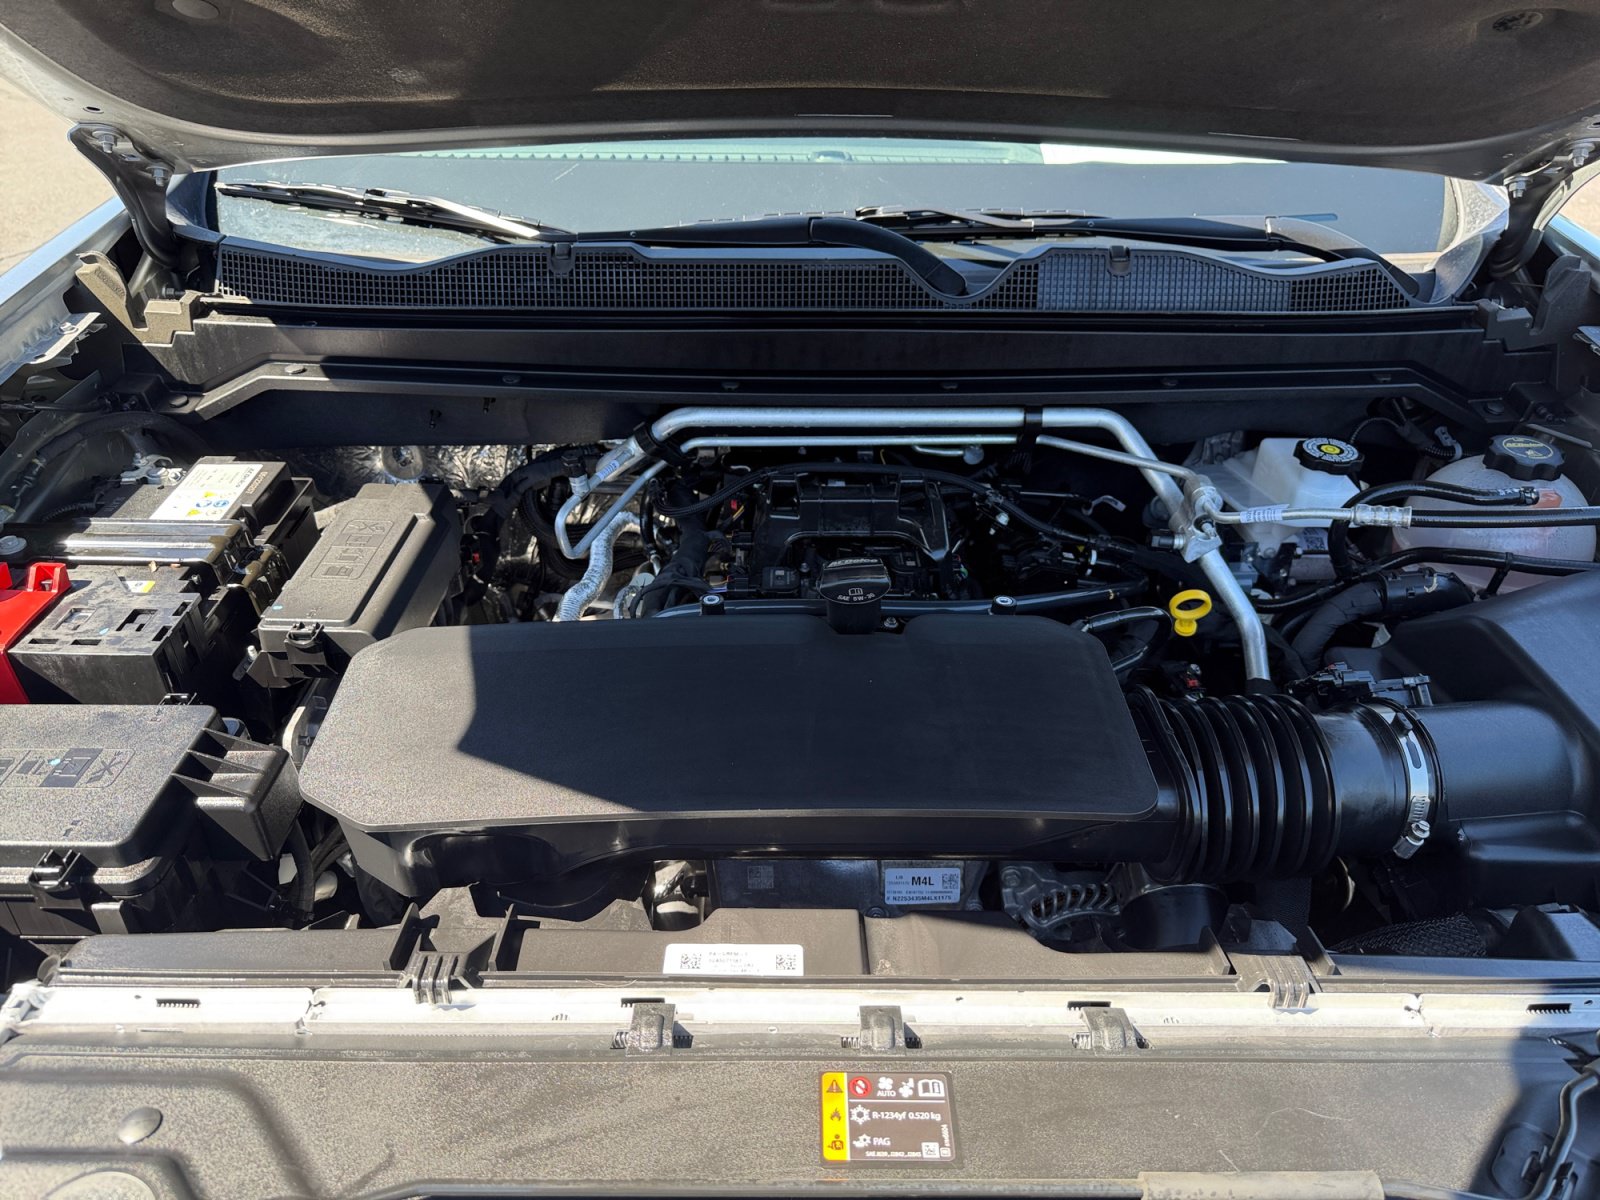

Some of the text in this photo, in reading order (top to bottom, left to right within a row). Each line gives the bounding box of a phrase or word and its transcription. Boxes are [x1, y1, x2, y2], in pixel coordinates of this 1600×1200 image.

[828, 558, 878, 567] ACDelco
[911, 876, 934, 886] M4L
[872, 1111, 942, 1121] R-1234yf 0.520 kg
[873, 1137, 891, 1145] PAG
